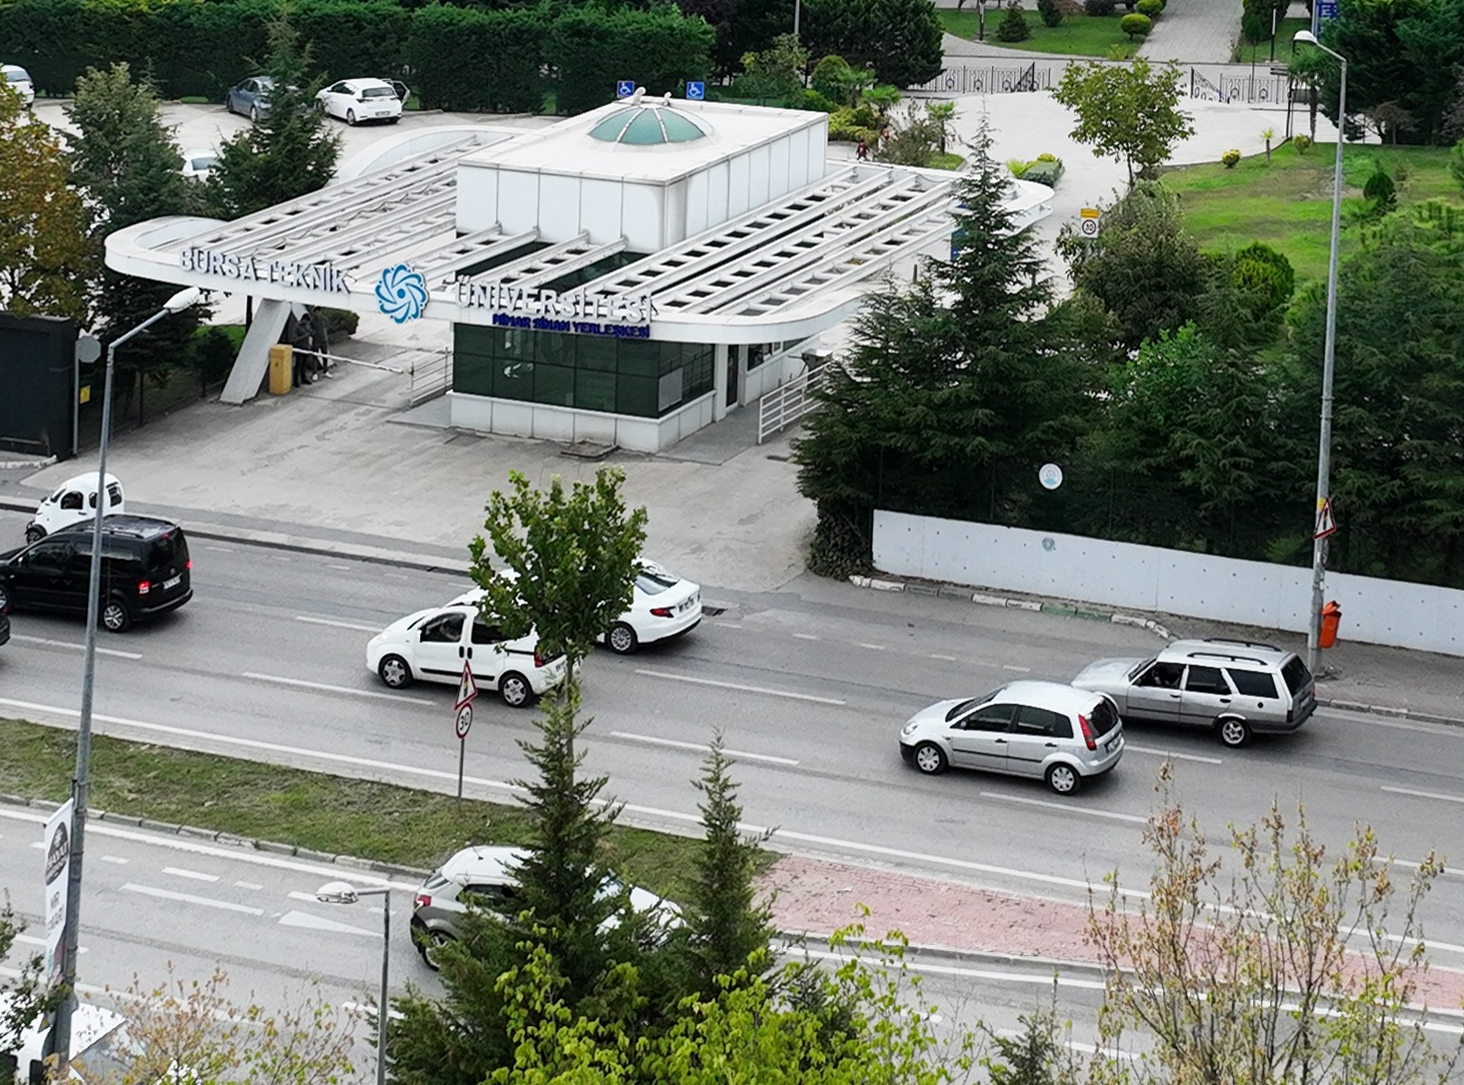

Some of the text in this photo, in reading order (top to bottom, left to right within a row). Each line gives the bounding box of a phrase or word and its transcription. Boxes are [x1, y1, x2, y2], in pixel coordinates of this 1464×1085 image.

[179, 245, 258, 282] BURSA
[454, 273, 652, 325] ÜNİVERSİTESİ
[459, 711, 470, 731] 30
